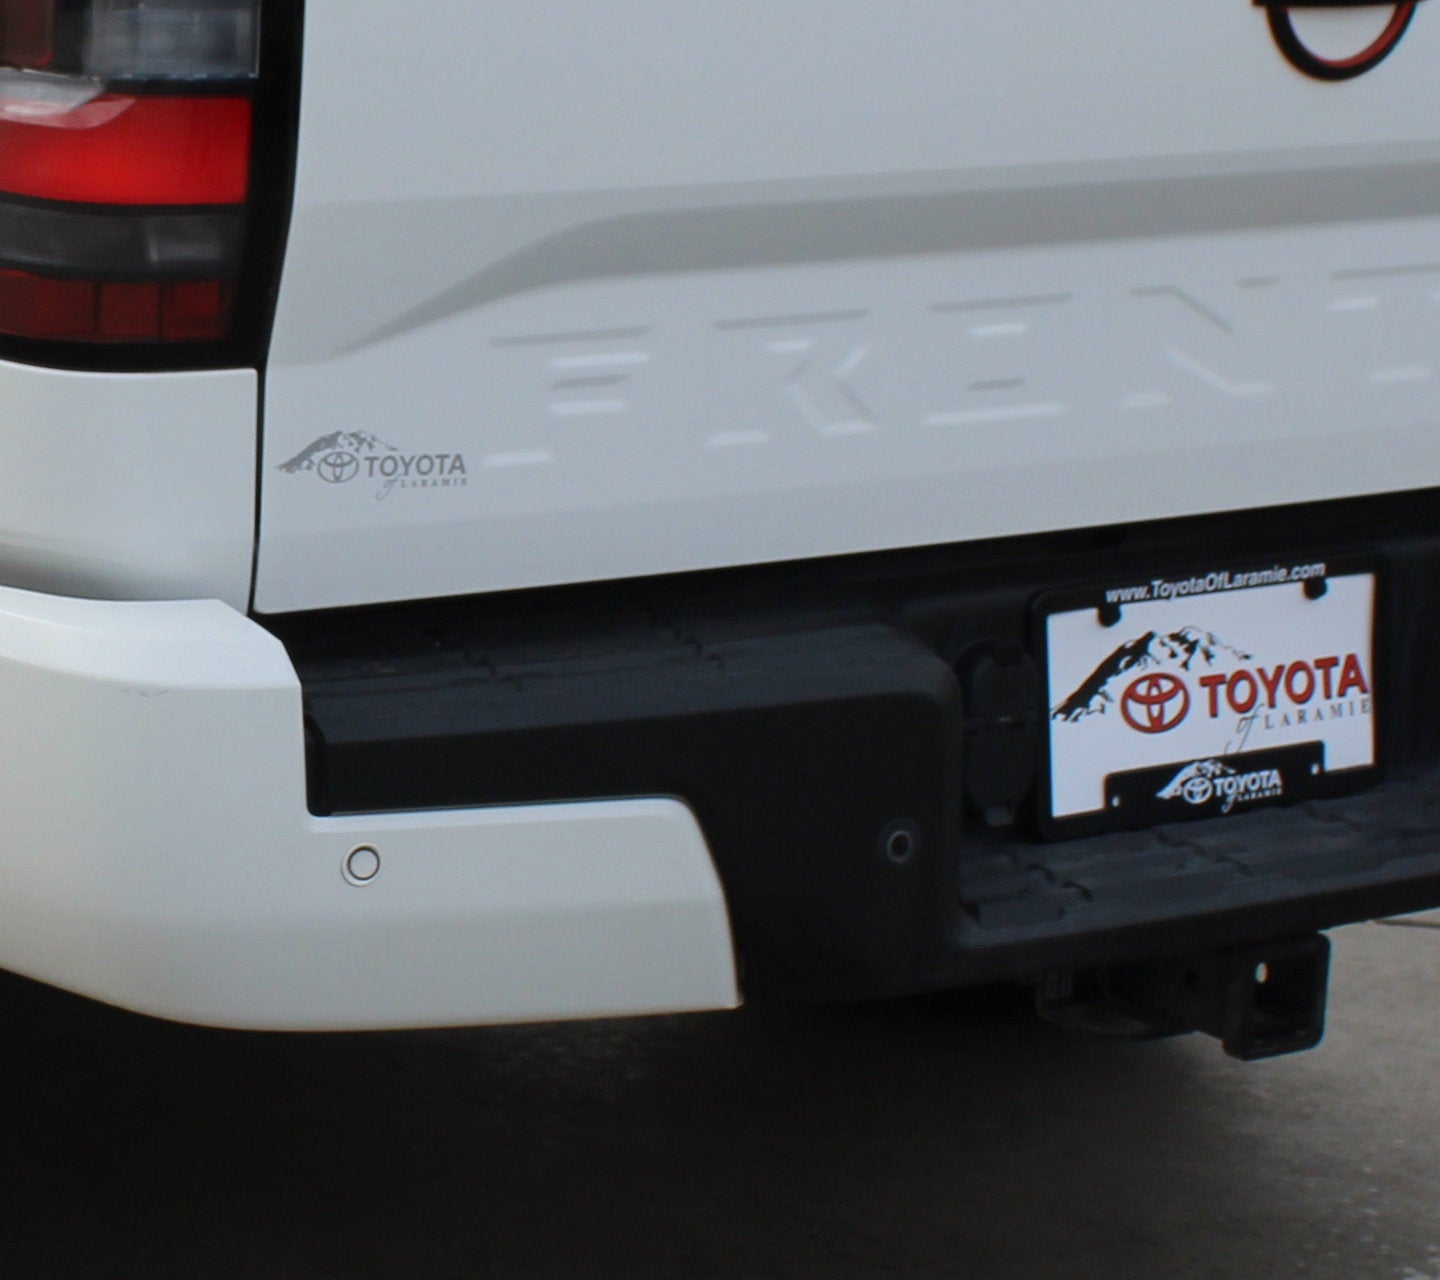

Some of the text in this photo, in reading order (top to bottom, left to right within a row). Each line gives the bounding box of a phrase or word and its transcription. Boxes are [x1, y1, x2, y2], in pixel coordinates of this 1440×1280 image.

[364, 454, 466, 478] TOYOTA
[401, 477, 468, 488] LARAMIE
[1105, 561, 1326, 604] www.ToyotaOfLaramie.com
[1199, 654, 1369, 718] TOYOTA
[1264, 697, 1371, 730] LARAMIE
[1213, 768, 1283, 797] TOYOTA
